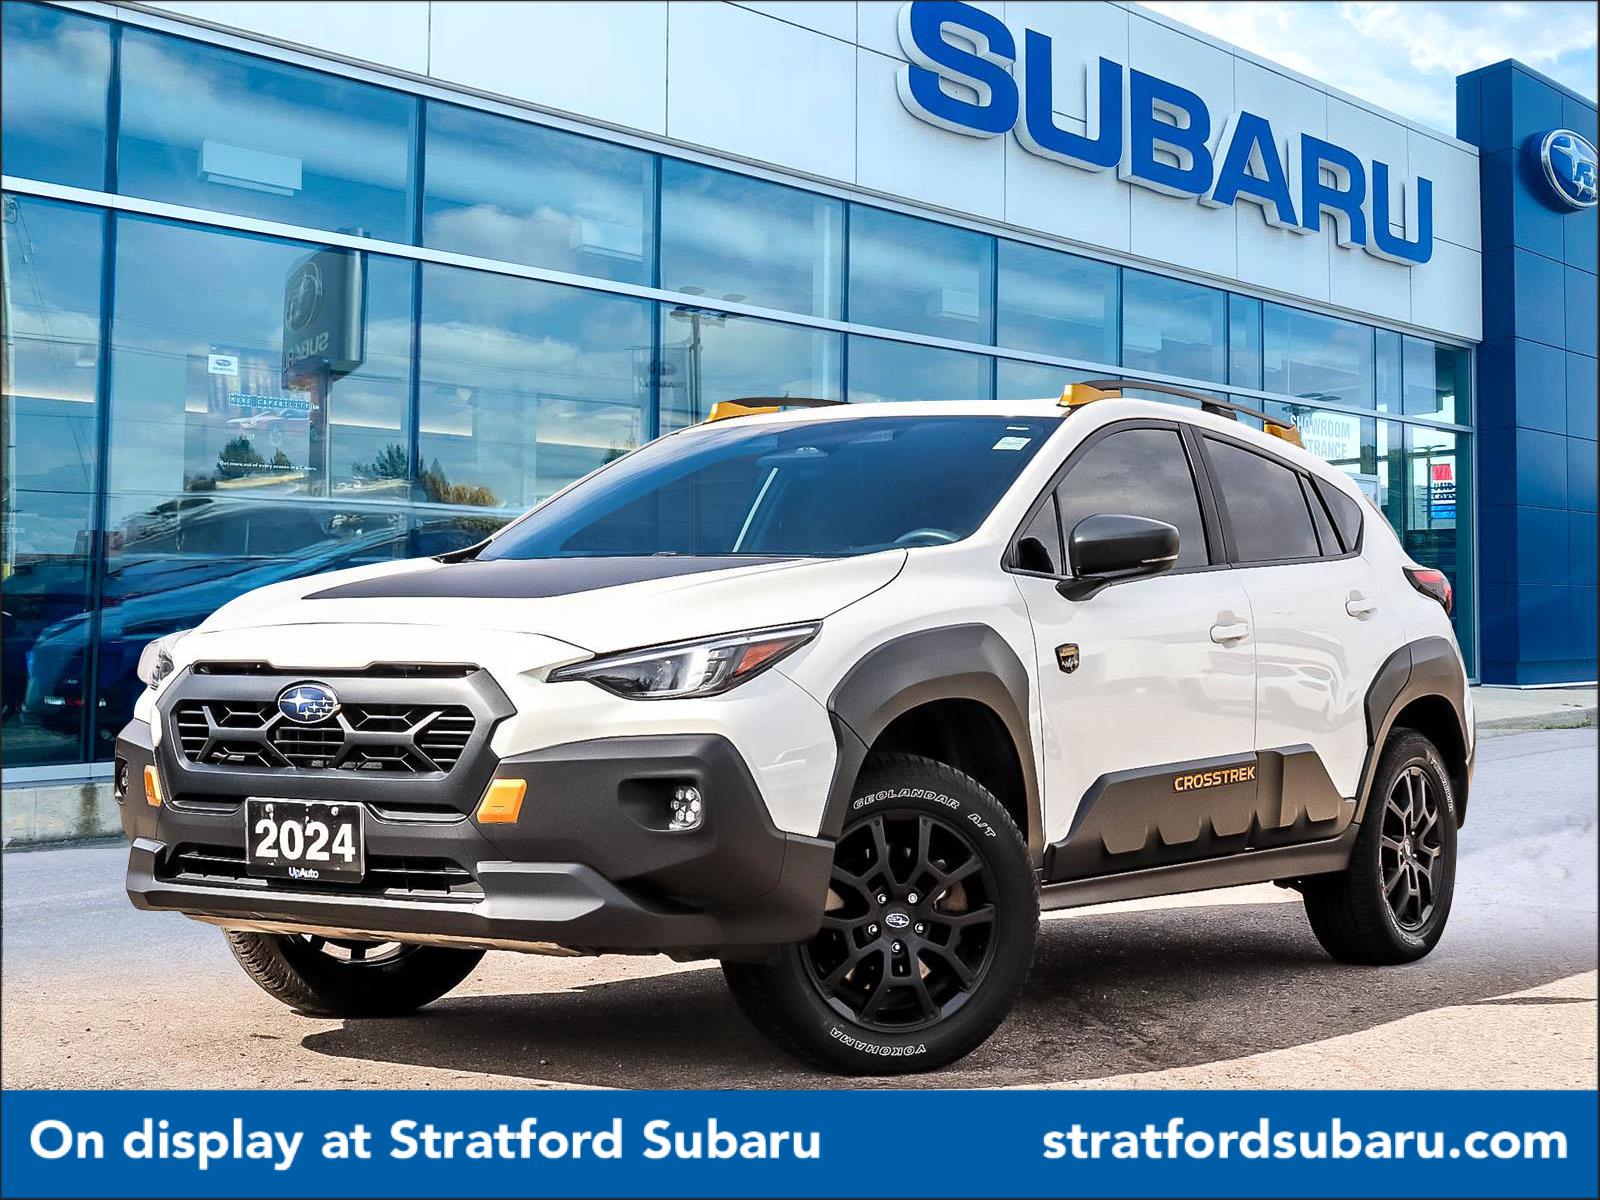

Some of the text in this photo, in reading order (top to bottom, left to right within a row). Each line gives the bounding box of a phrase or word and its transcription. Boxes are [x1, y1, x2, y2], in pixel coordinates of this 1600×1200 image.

[900, 0, 1432, 265] SUBARU
[1290, 414, 1350, 440] SHOWROOM
[1174, 766, 1256, 792] CROSSTREK
[853, 788, 996, 838] GEOLANDAR A/T
[255, 818, 356, 863] 2024
[288, 866, 319, 879] UpAuto
[830, 1027, 927, 1057] YOKOHAMA
